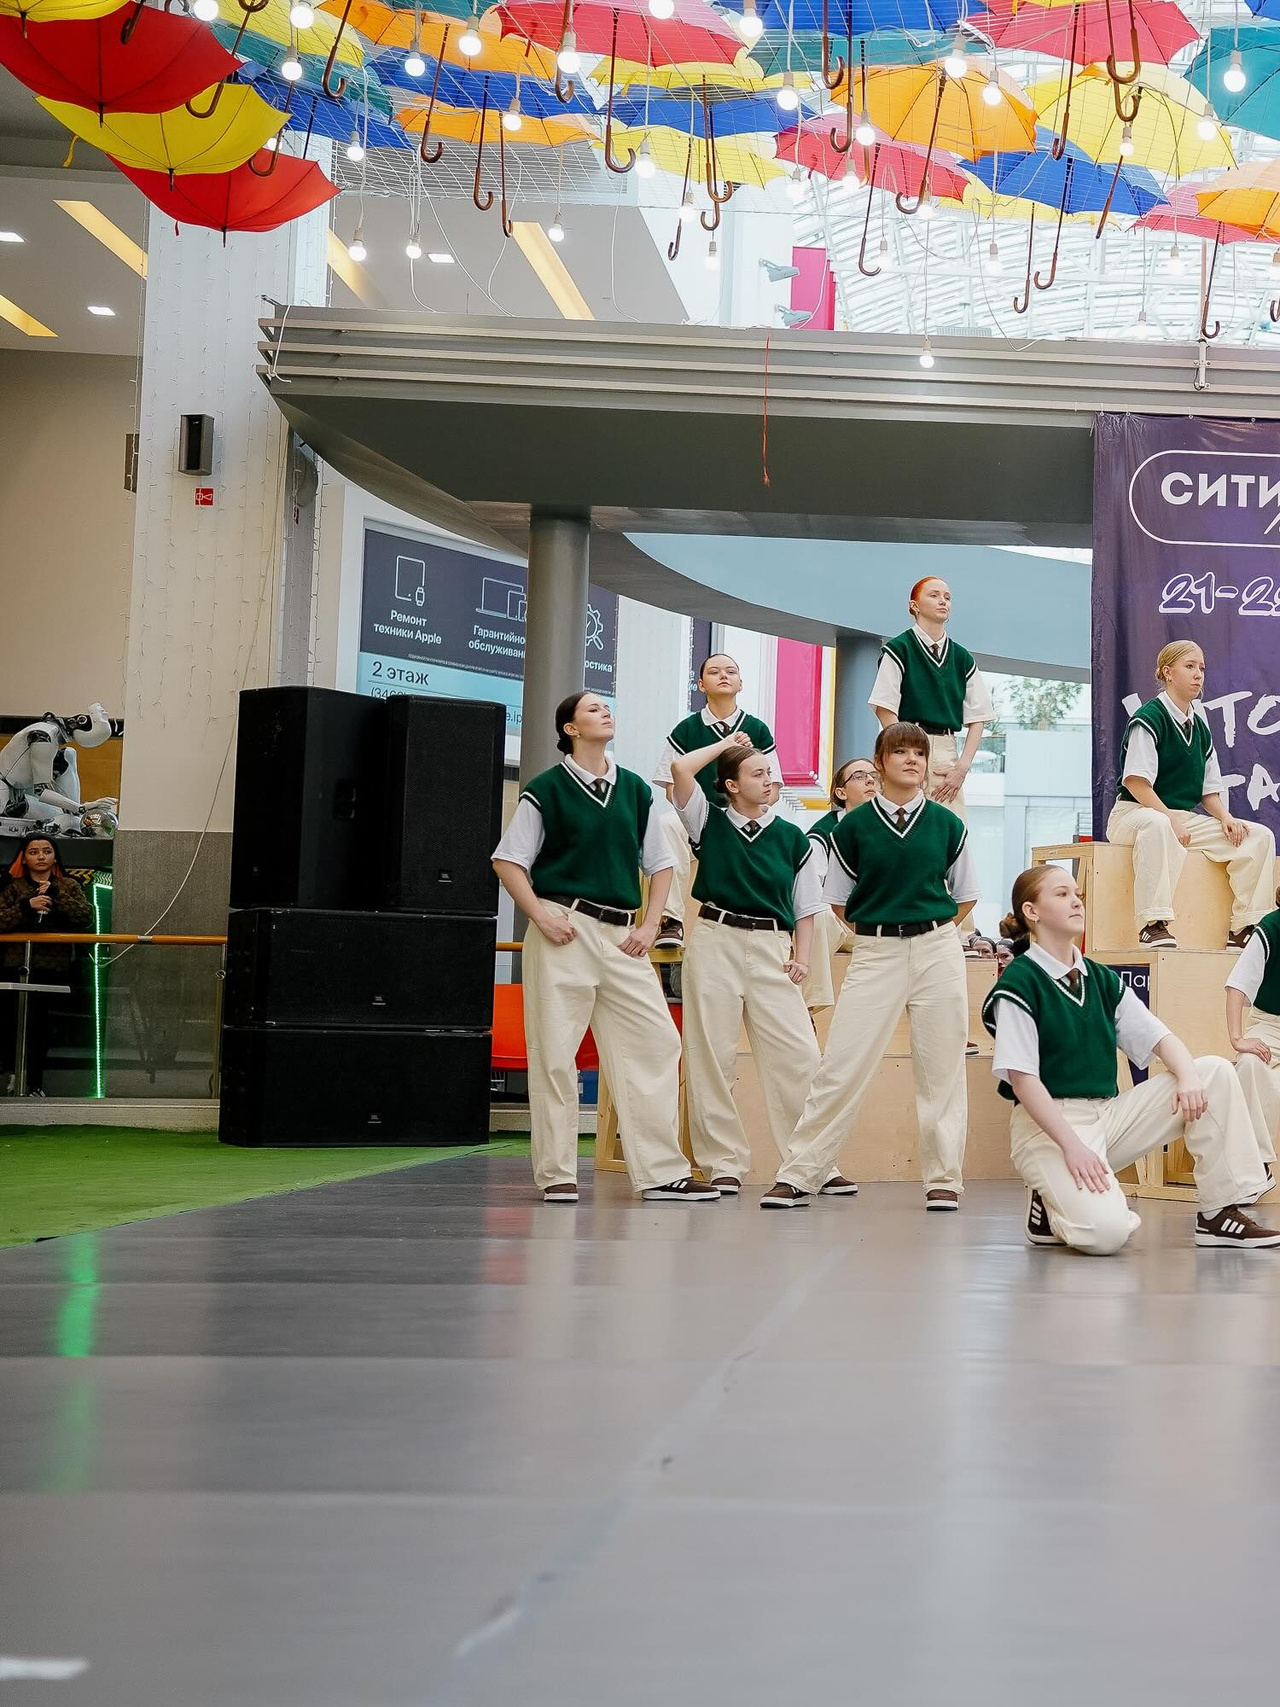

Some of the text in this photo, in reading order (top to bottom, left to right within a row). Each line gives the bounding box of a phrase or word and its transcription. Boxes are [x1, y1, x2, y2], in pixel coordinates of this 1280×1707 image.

[389, 609, 428, 627] Ремонт
[373, 623, 442, 646] техники Apple
[468, 639, 526, 660] обслуживан
[371, 660, 430, 687] 2 этаж
